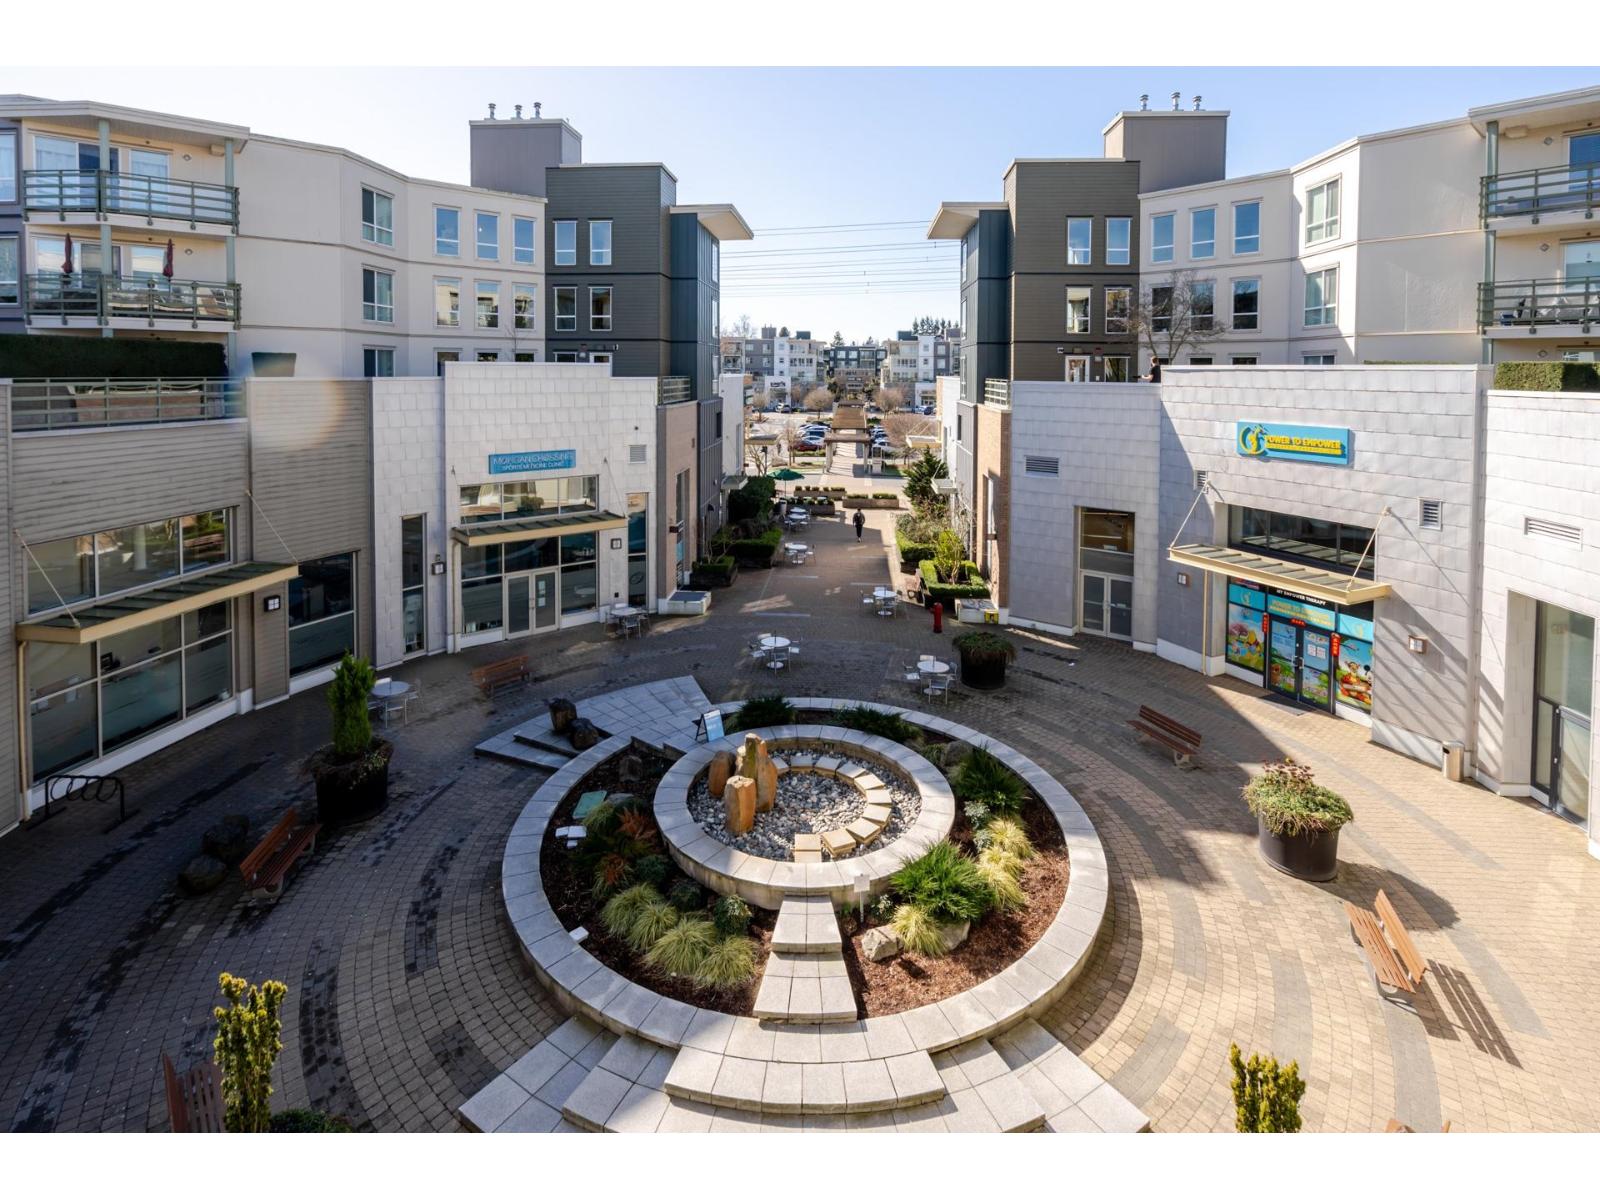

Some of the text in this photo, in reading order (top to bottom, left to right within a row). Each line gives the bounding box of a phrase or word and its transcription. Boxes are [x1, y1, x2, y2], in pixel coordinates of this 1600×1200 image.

[1264, 434, 1290, 444] POWER
[1292, 436, 1301, 446] TO
[1303, 437, 1342, 449] EMPOWER
[493, 454, 531, 464] MORGAN
[1306, 596, 1326, 606] THERAPY
